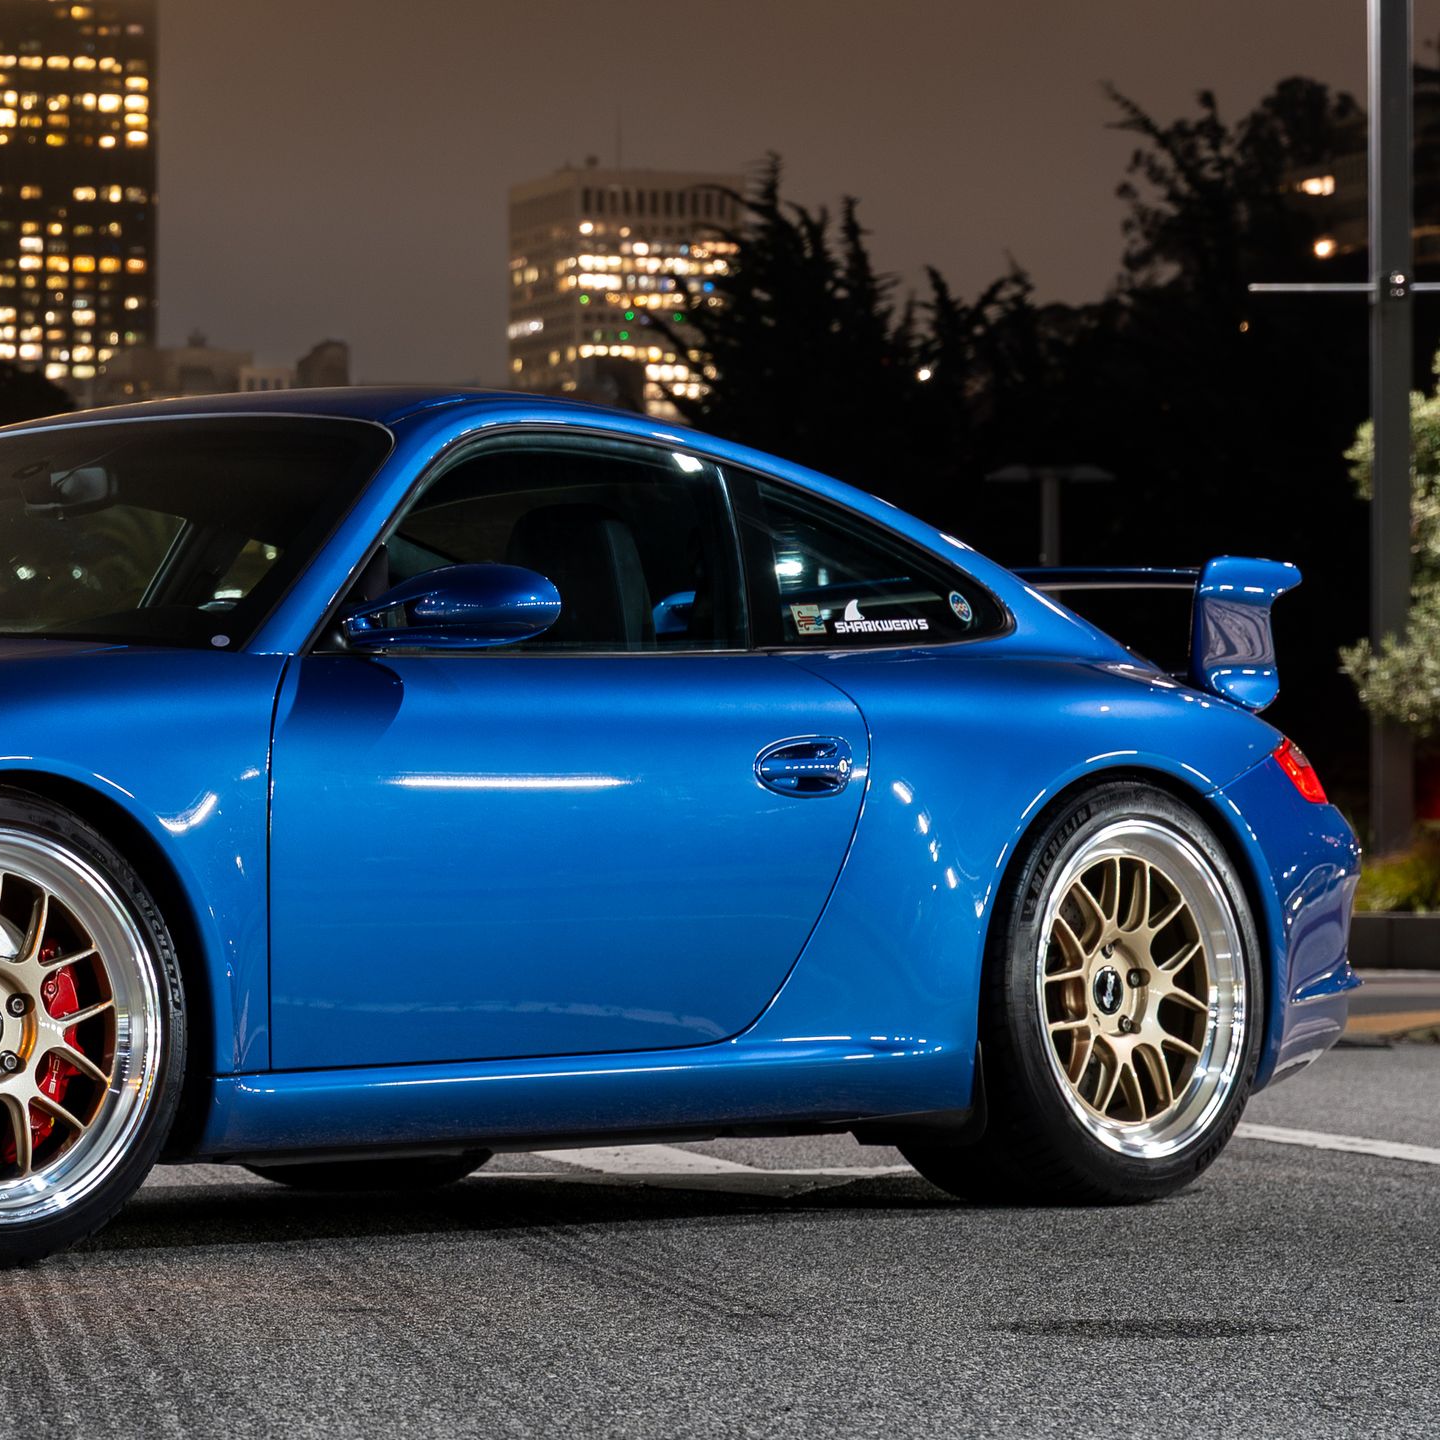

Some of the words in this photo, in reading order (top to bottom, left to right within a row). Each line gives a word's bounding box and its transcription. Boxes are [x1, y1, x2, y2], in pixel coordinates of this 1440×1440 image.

[834, 619, 929, 634] SHARKWERKS
[1030, 803, 1089, 894] MICHELIN
[136, 890, 181, 1004] MICHELIN
